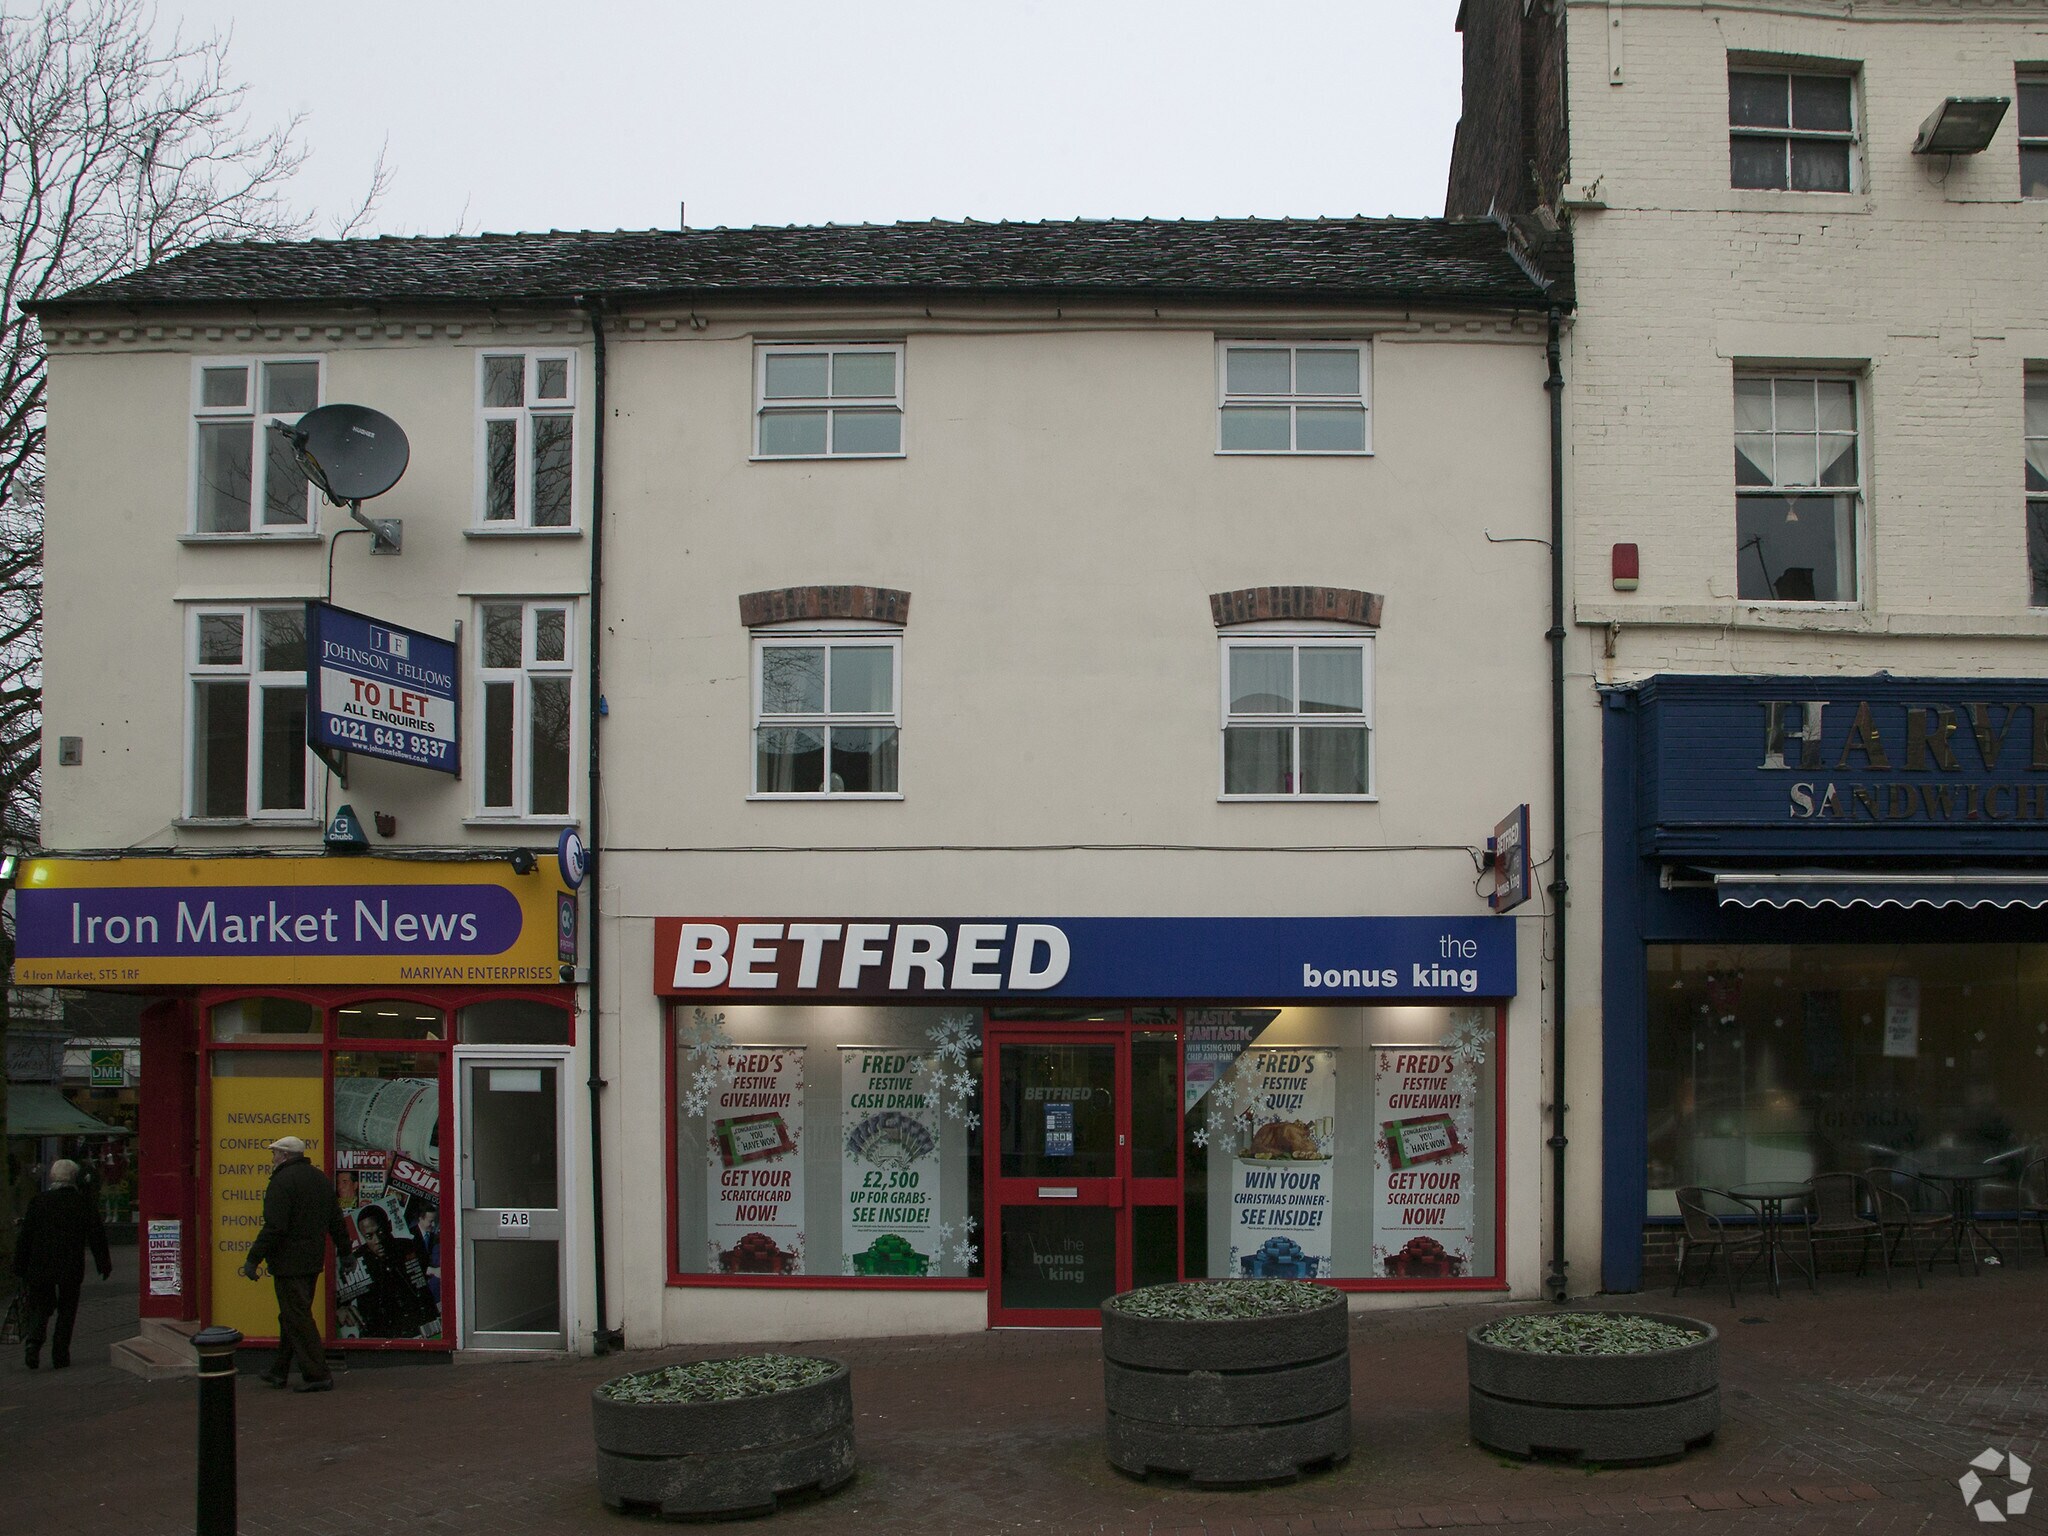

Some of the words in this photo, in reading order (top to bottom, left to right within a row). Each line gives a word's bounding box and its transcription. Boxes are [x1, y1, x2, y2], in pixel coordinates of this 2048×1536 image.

[323, 640, 389, 671] JOHNSON
[397, 661, 452, 688] FELLOWS
[350, 678, 380, 706] TO
[389, 688, 429, 718] LET
[344, 702, 367, 717] ALL
[372, 708, 435, 733] ENQUIRIES
[330, 717, 368, 742] 0121
[374, 727, 405, 750] 643
[411, 736, 447, 759] 9337
[1790, 782, 2047, 820] SANDWICH
[72, 901, 159, 944] Iron
[176, 900, 338, 944] Market
[355, 899, 478, 942] News
[1439, 934, 1478, 959] the
[673, 923, 1071, 990] BETFRED
[23, 970, 30, 980] 4
[32, 970, 53, 980] Iron
[56, 970, 96, 981] Market,
[99, 969, 118, 980] ST5
[122, 969, 140, 980] 1RF
[401, 966, 463, 979] MARIYAN
[467, 966, 553, 979] ENTERPRISES
[1303, 963, 1398, 988] bonus
[1413, 963, 1478, 992] king
[1185, 1010, 1236, 1025] PLASTIC
[1185, 1025, 1253, 1041] FANTASTIC
[1186, 1044, 1201, 1052] WIN
[1201, 1043, 1222, 1052] USING
[1223, 1043, 1242, 1052] YOUR
[727, 1054, 784, 1073] FRED'S
[1186, 1053, 1203, 1061] CHIP
[1203, 1053, 1218, 1061] AND
[1256, 1054, 1315, 1074] FRED'S
[1396, 1055, 1455, 1074] FRED'S
[733, 1076, 777, 1089] FESTIVE
[868, 1077, 913, 1090] FESTIVE
[1262, 1077, 1308, 1090] FESTIVE
[1402, 1077, 1448, 1090] FESTIVE
[720, 1093, 791, 1108] GIVEAWAY!
[851, 1093, 884, 1108] CASH
[1024, 1086, 1092, 1101] BETFRED
[1266, 1093, 1304, 1110] QUIZ!
[1389, 1094, 1461, 1109] GIVEAWAY!
[227, 1113, 311, 1124] NEWSAGENTS
[749, 1130, 764, 1140] YOU
[1419, 1132, 1433, 1141] YOU
[219, 1138, 319, 1150] CONFECTRY
[741, 1140, 761, 1151] HAVE
[760, 1137, 776, 1146] WON
[1410, 1142, 1429, 1153] HAVE
[1429, 1138, 1446, 1149] WON
[336, 1150, 386, 1169] Mirror
[219, 1164, 255, 1175] DAIRY
[360, 1171, 384, 1183] FREE
[393, 1160, 440, 1193] Sun
[721, 1170, 749, 1186] GET
[751, 1170, 791, 1187] YOUR
[862, 1171, 920, 1191] £2,500
[1245, 1171, 1277, 1189] WIN
[1280, 1172, 1321, 1190] YOUR
[1388, 1172, 1417, 1190] GET
[1419, 1172, 1461, 1190] YOUR
[720, 1189, 791, 1201] SCRATCHCARD
[850, 1191, 865, 1203] UP
[867, 1191, 889, 1204] FOR
[890, 1192, 926, 1204] GRABS
[1234, 1193, 1287, 1205] CHRISTMAS
[1387, 1193, 1460, 1205] SCRATCHCARD
[501, 1213, 529, 1225] 5AB
[736, 1204, 778, 1222] NOW!
[852, 1207, 876, 1222] SEE
[878, 1207, 930, 1223] INSIDE!
[1240, 1208, 1267, 1225] SEE
[1268, 1209, 1323, 1226] INSIDE!
[1402, 1208, 1446, 1225] NOW!
[219, 1240, 252, 1252] CRISP
[1063, 1237, 1084, 1251] the
[1033, 1252, 1084, 1265] bonus
[1048, 1267, 1085, 1283] king
